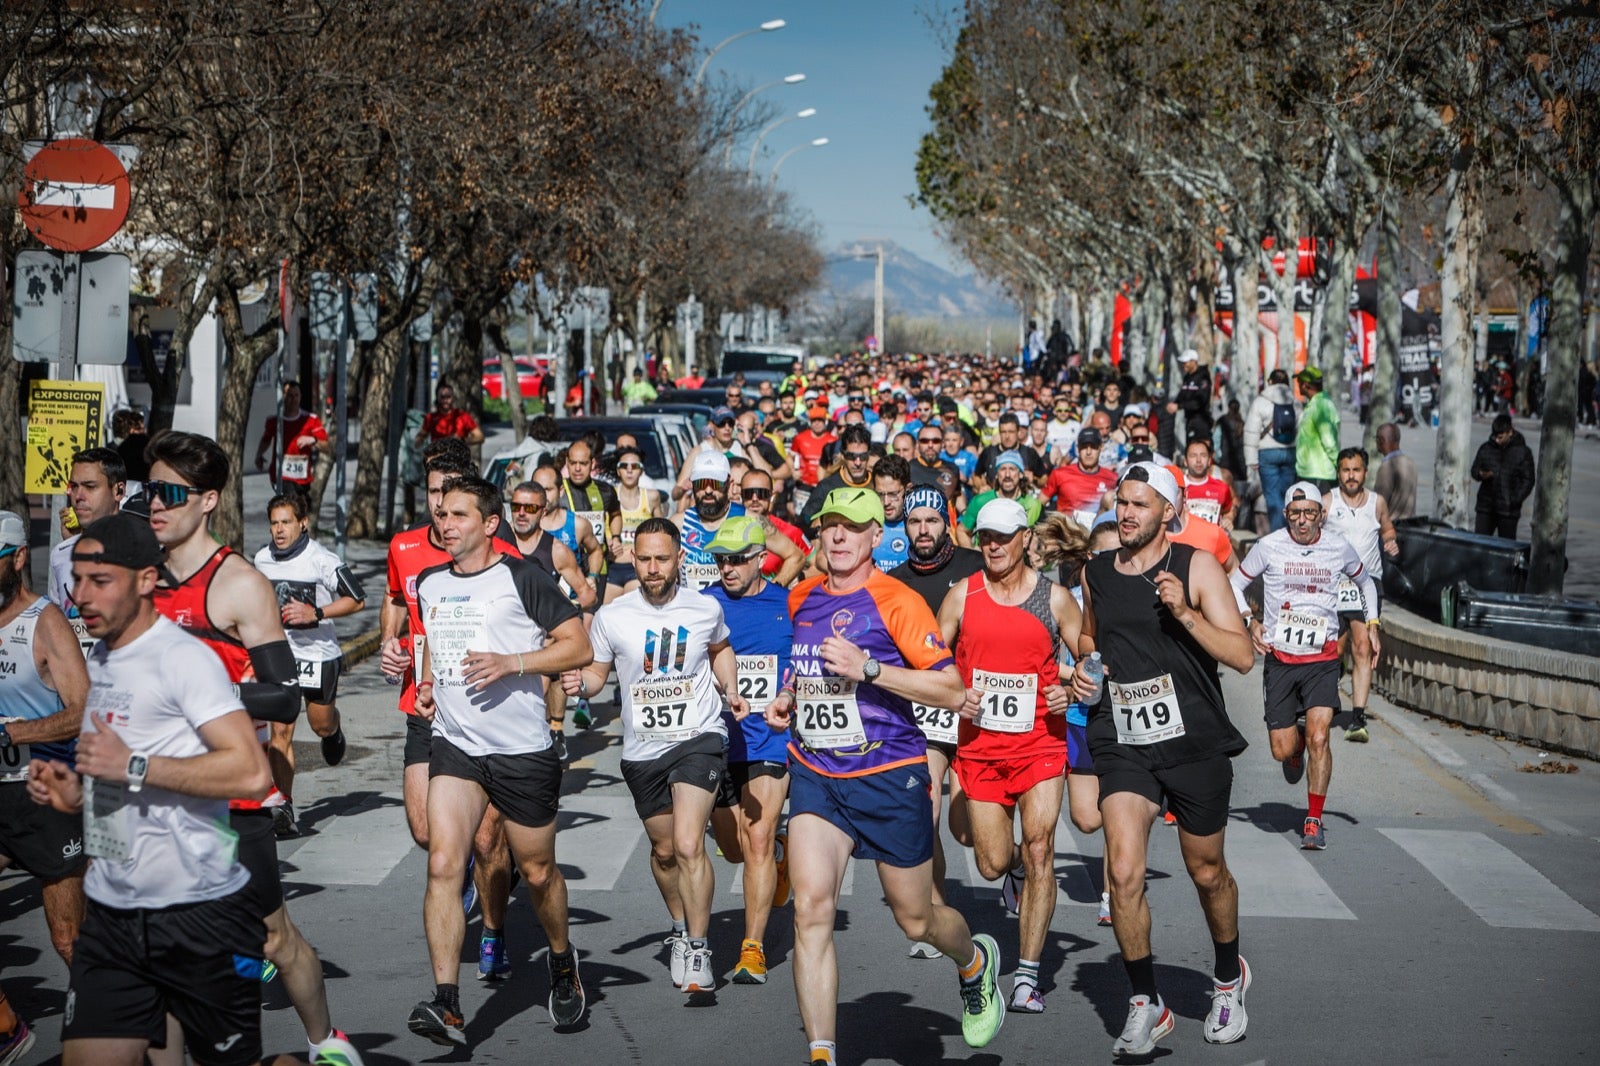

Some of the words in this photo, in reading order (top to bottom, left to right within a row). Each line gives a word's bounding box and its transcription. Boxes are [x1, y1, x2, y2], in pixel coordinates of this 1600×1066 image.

[34, 391, 100, 401] EXPOSICION
[1283, 567, 1304, 575] MEDIA
[1341, 590, 1358, 602] 29
[1288, 614, 1318, 626] FONDO
[1283, 627, 1316, 646] 111
[804, 683, 841, 695] FONDO
[985, 677, 1025, 689] FONDO
[643, 687, 682, 699] FONDO
[987, 694, 1018, 717] 16
[642, 703, 687, 728] 357
[804, 703, 849, 730] 265
[915, 706, 955, 729] 243
[1121, 702, 1171, 731] 719
